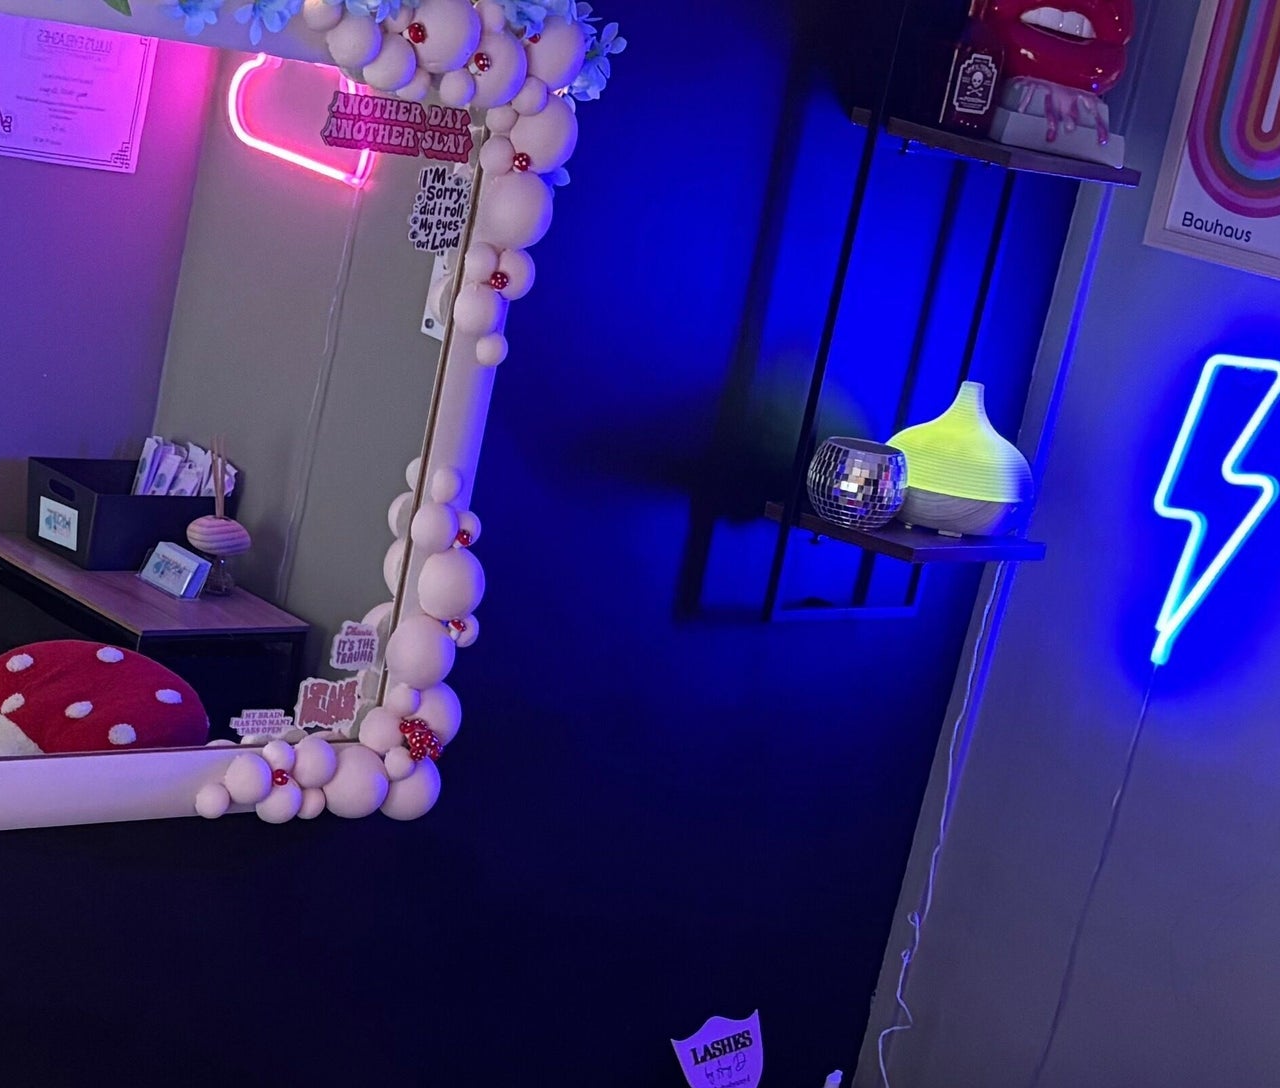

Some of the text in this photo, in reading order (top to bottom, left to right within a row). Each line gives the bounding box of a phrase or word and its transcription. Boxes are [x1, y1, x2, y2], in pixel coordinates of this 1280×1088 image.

[331, 92, 422, 124] ANOTHER
[323, 117, 469, 154] ANOTHER SLAY
[419, 201, 437, 216] did
[444, 203, 465, 218] roll
[419, 217, 460, 237] My eyes
[1181, 211, 1252, 243] Bauhaus
[416, 232, 461, 251] out Loud
[337, 638, 376, 652] IT'S THE
[336, 650, 374, 665] TRAUMA
[690, 1029, 753, 1066] LASHES
